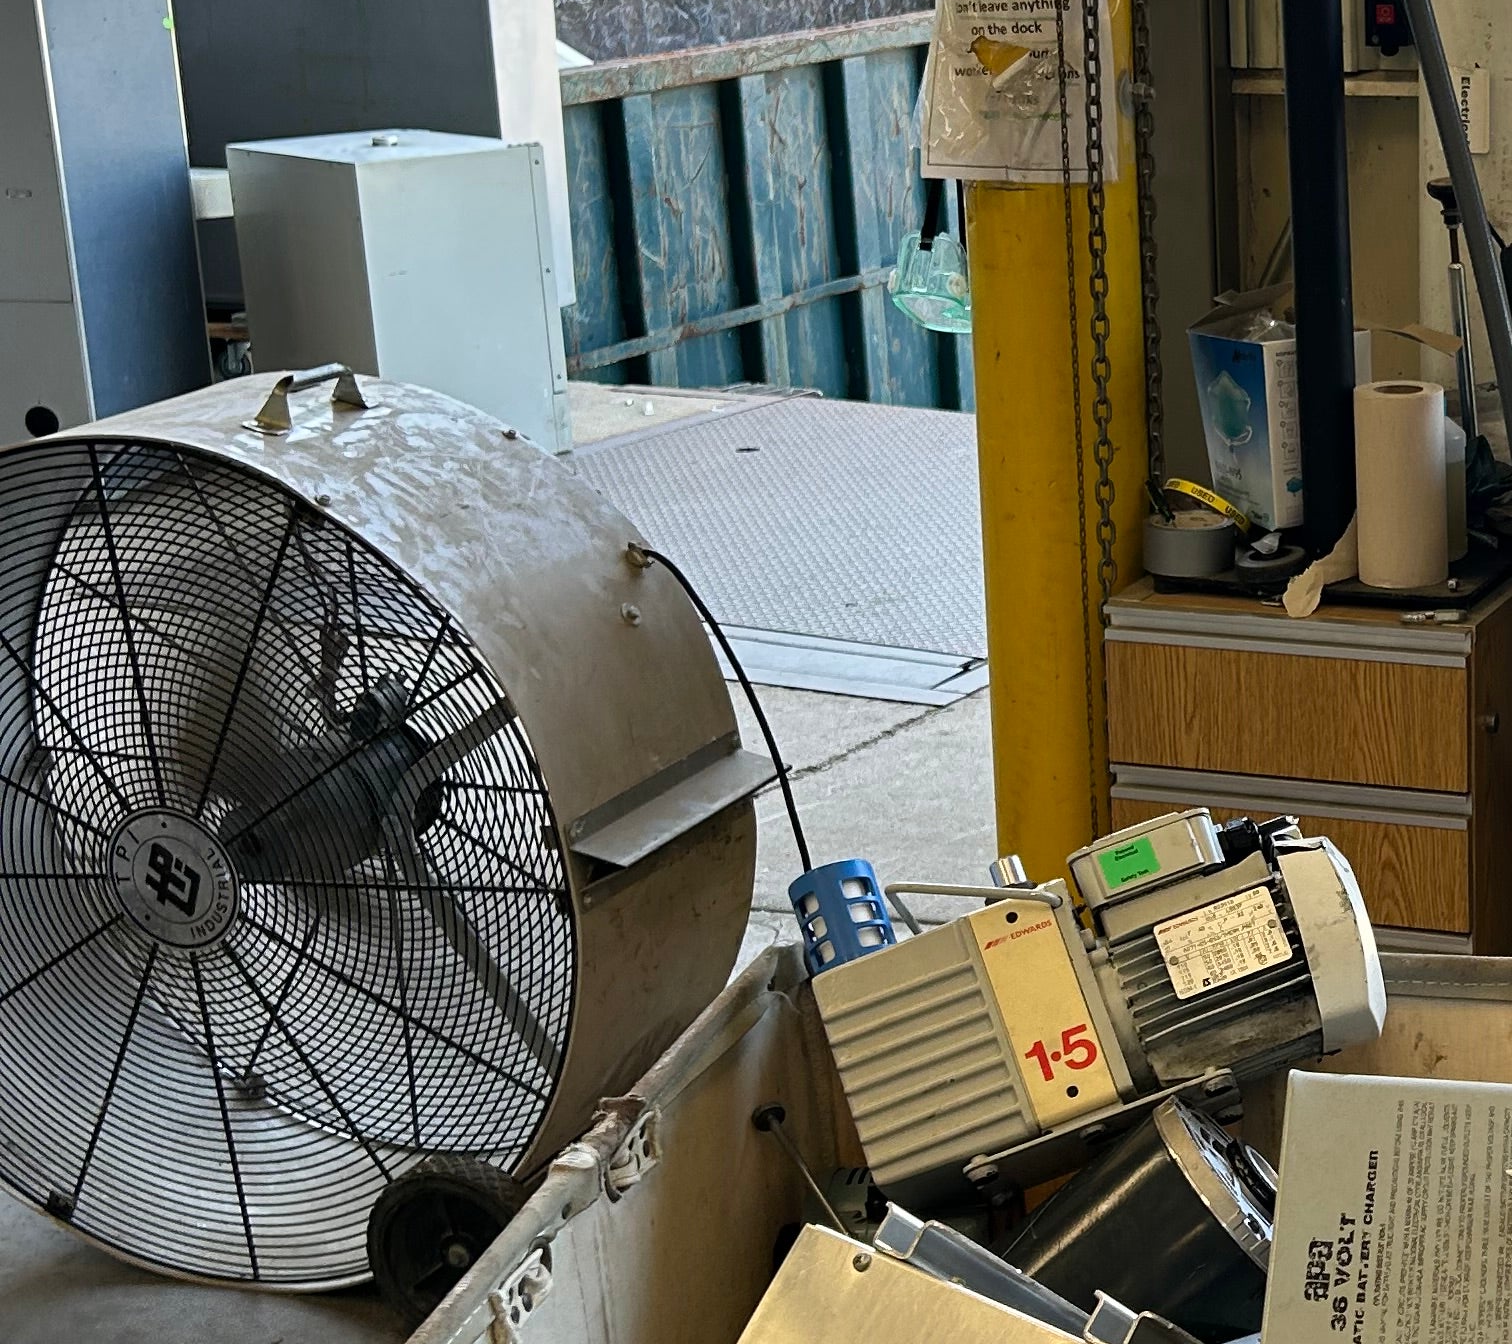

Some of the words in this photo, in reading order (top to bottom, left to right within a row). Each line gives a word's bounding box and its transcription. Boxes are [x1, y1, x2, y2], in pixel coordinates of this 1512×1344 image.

[956, 0, 977, 14] on't
[979, 0, 1009, 14] leave
[971, 25, 986, 37] on
[988, 22, 1008, 36] the
[1011, 20, 1043, 34] dock
[189, 847, 232, 940] INDUSTRIAL
[1010, 919, 1053, 940] EDWARDS
[1363, 1150, 1379, 1226] CHARGER
[1333, 1212, 1356, 1288] VOLT
[1330, 1296, 1349, 1332] 36
